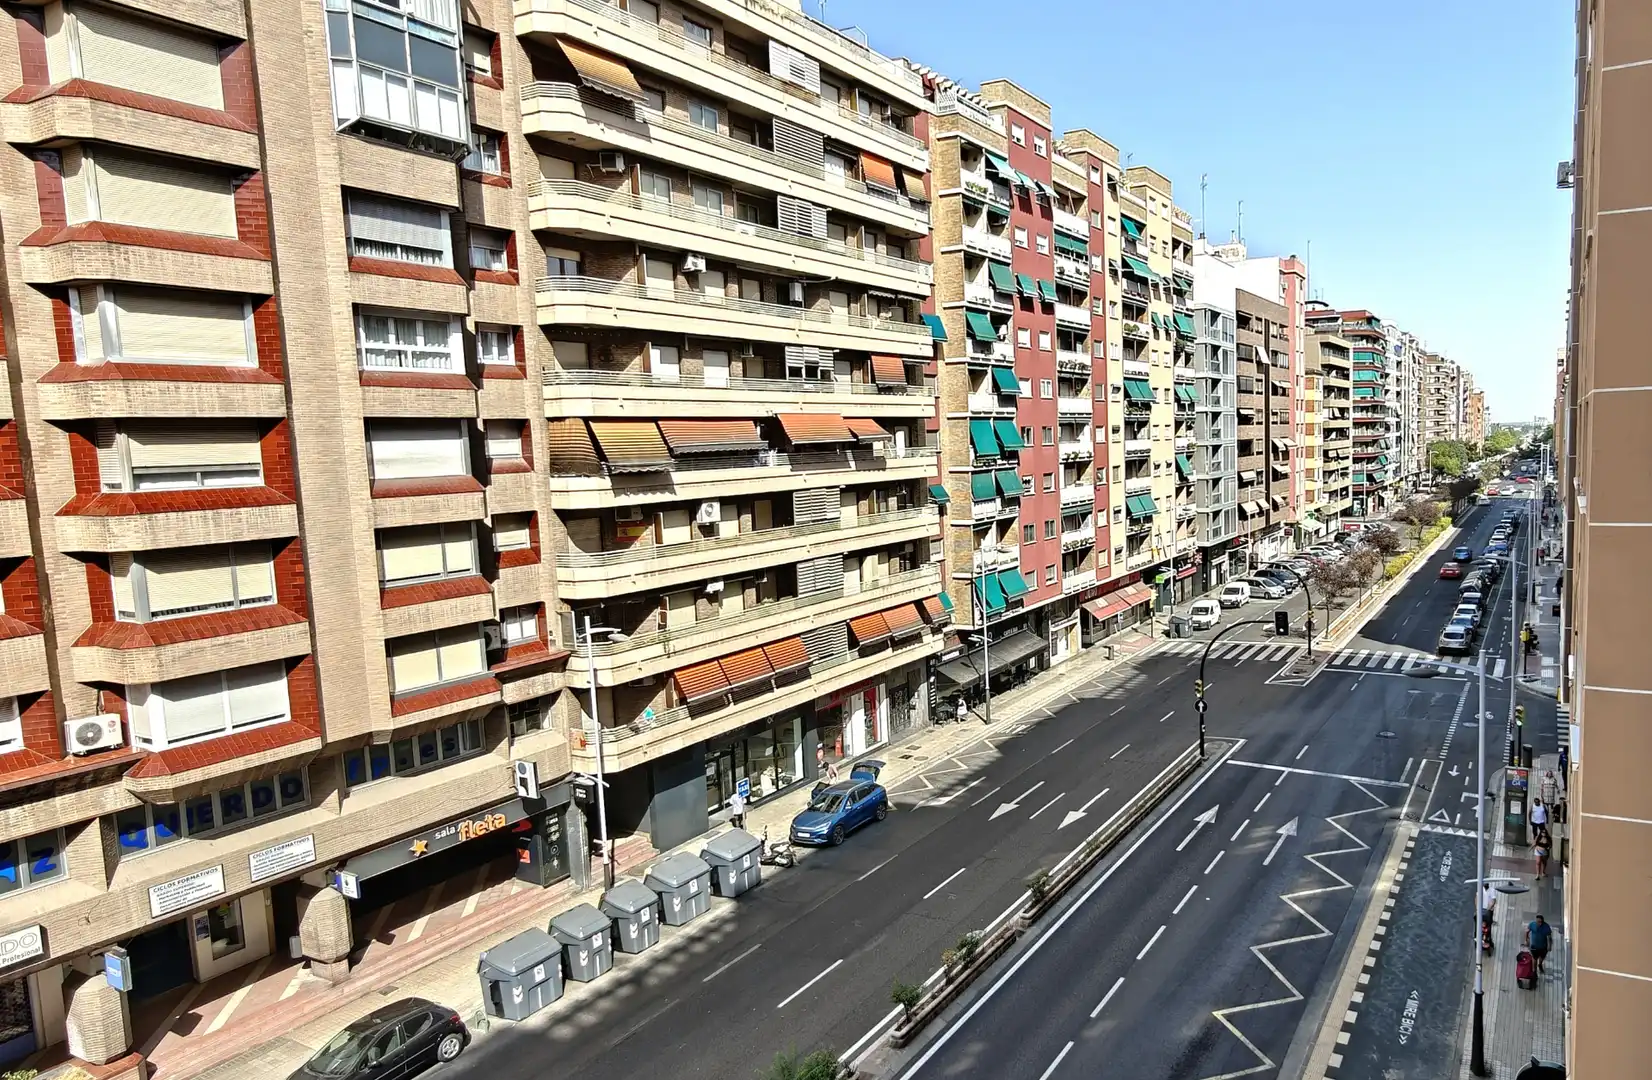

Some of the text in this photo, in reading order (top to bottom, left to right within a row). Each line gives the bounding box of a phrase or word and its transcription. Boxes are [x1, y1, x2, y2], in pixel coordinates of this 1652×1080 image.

[434, 813, 506, 842] sala fleta
[252, 836, 310, 859] CICLOS FORMATIVOS
[153, 867, 218, 893] CICLOS FORMATIVOS
[2, 946, 41, 964] Profesional
[1398, 998, 1420, 1035] MIRE BICI
